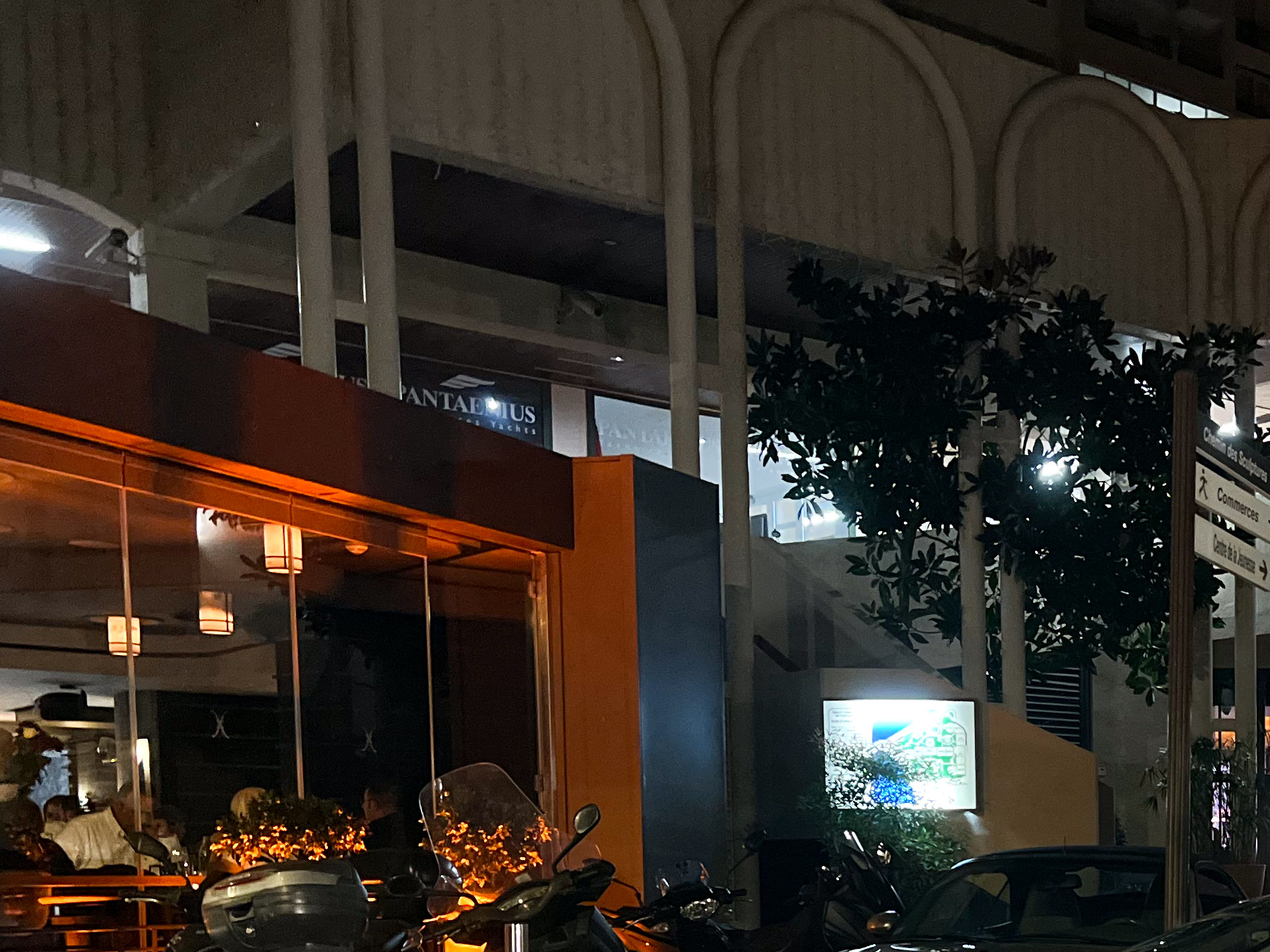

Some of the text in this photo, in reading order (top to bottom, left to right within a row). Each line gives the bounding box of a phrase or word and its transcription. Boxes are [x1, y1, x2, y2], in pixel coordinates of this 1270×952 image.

[491, 420, 537, 435] Yachts
[1203, 426, 1268, 483] Chemin des Sculptures
[1216, 487, 1259, 523] Commerces
[1213, 533, 1256, 575] Centre de la Jeunesse
